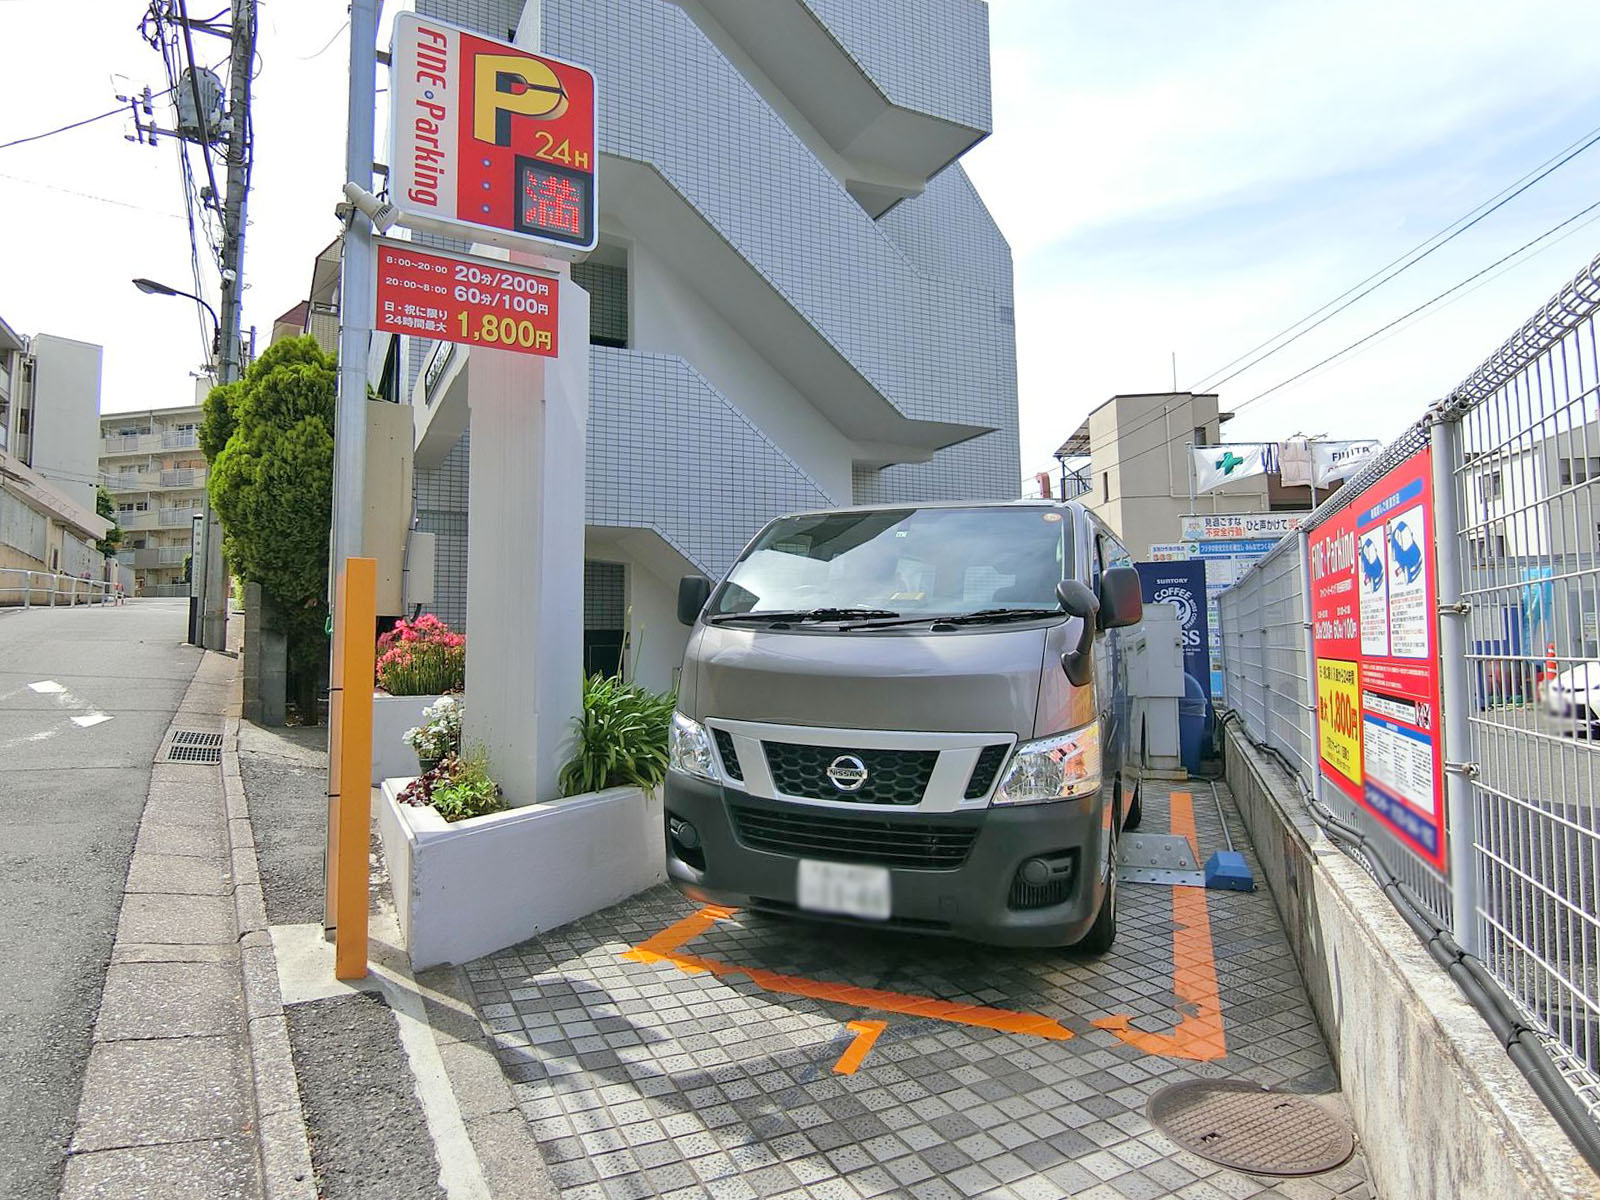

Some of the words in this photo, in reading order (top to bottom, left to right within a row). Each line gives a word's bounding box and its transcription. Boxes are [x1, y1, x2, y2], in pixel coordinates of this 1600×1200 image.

[535, 130, 589, 169] 24H
[525, 169, 580, 235] 満
[454, 264, 549, 297] 20分/200円
[454, 285, 549, 316] 60分/100円
[384, 313, 448, 334] 24時間最大
[457, 310, 552, 350] 1,800円
[1153, 586, 1193, 601] COFFEE
[829, 768, 865, 778] NISSAN
